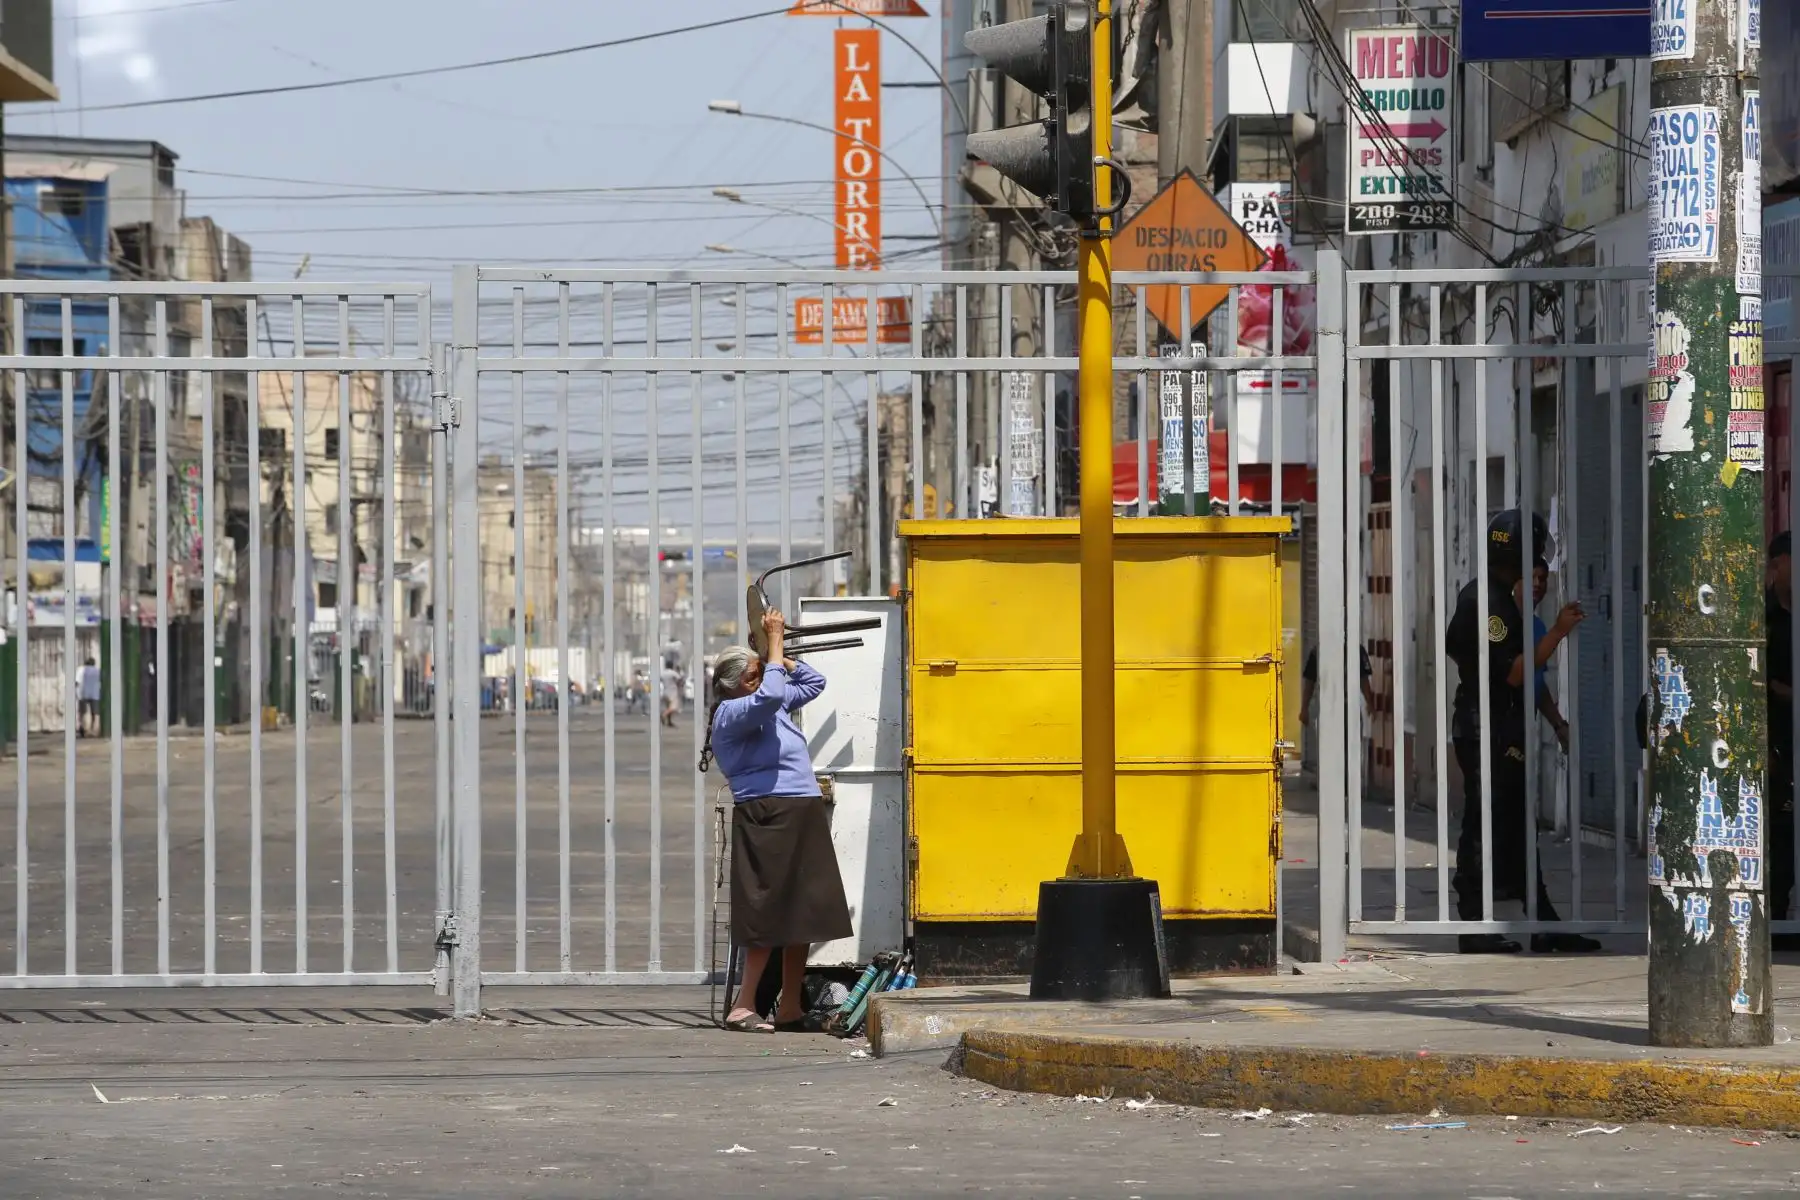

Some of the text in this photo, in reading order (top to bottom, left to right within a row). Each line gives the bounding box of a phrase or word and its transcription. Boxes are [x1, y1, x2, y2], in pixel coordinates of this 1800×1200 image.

[1357, 36, 1450, 79] MENU
[1361, 148, 1442, 167] PLATOS
[1360, 176, 1443, 195] EXTRAS
[1243, 200, 1277, 218] PA
[1243, 221, 1283, 233] CHA
[1136, 227, 1227, 249] DESPACIO
[1147, 253, 1217, 271] OBRAS
